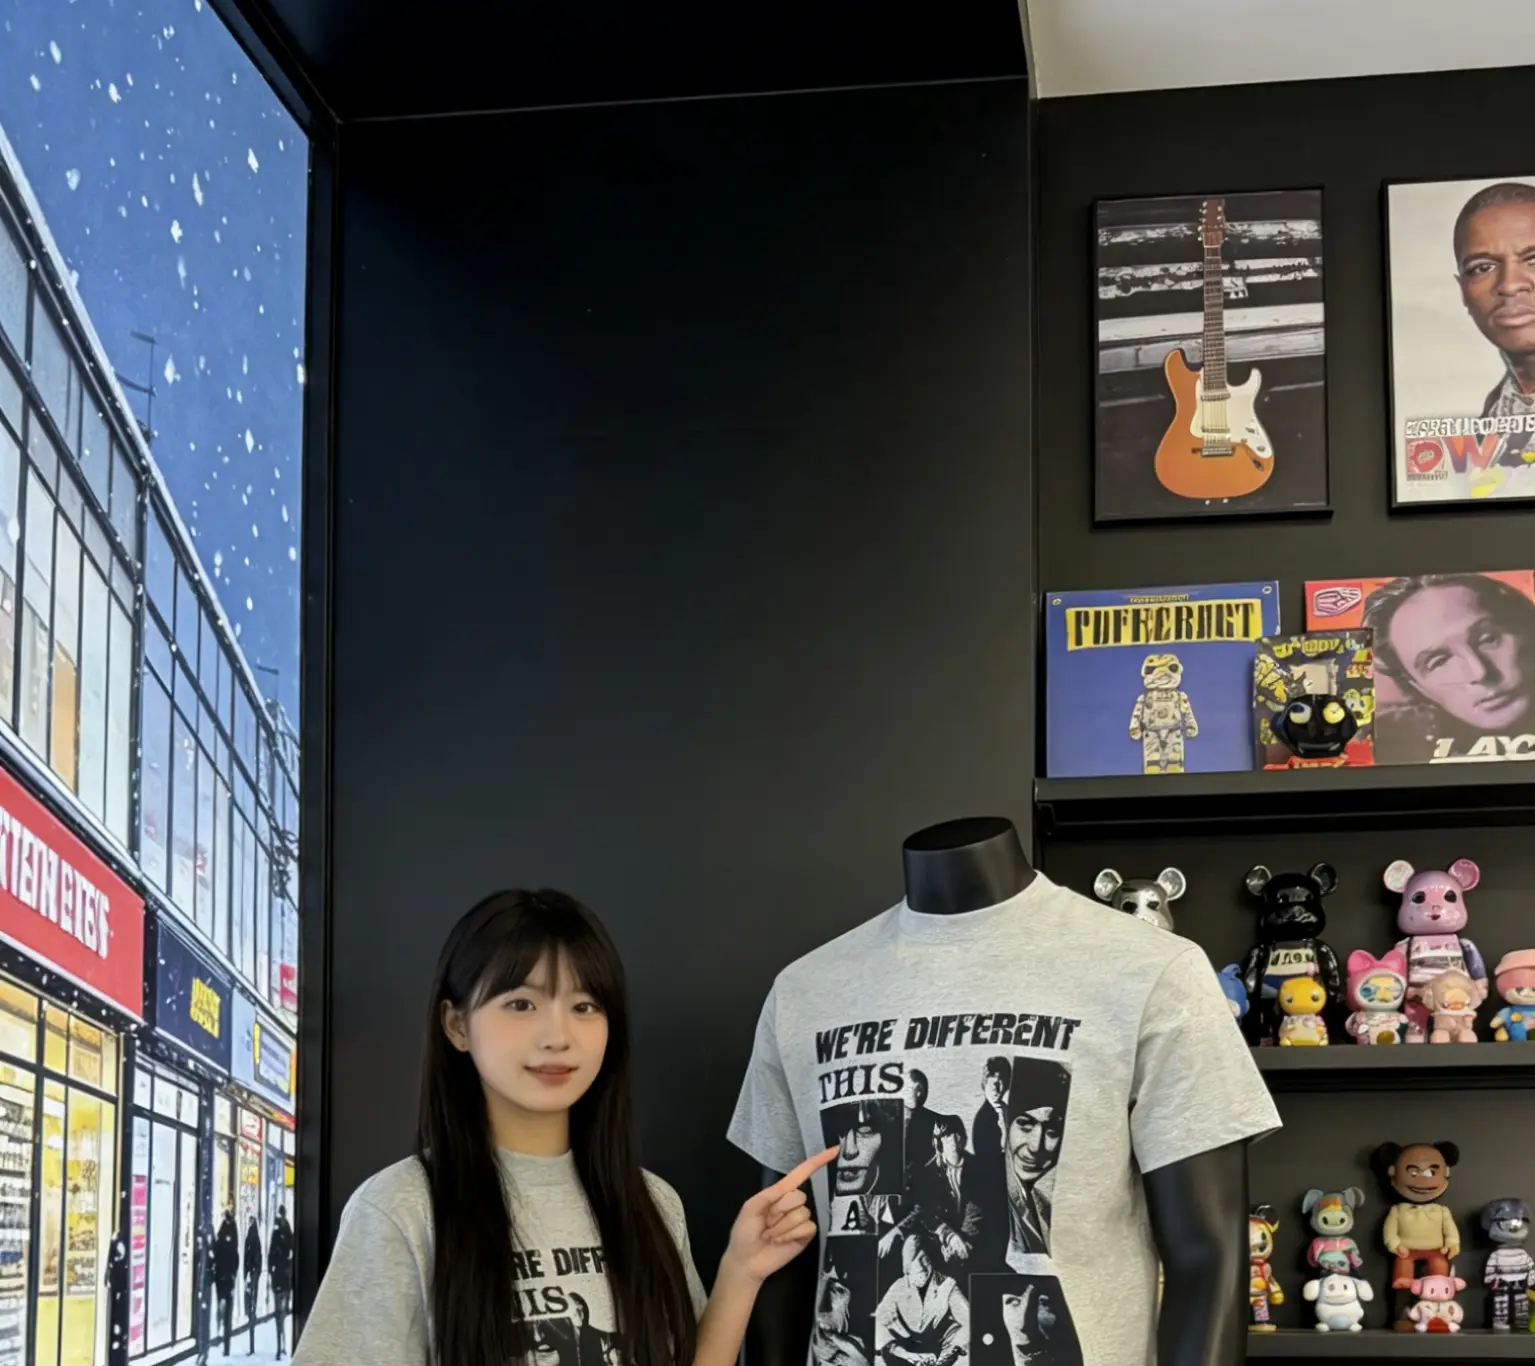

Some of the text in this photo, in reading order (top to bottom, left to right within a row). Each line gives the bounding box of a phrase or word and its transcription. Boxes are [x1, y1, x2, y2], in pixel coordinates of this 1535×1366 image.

[815, 1012, 1082, 1065] WE'RE DIFFERENT
[818, 1062, 905, 1104] THIS
[840, 1199, 863, 1231] A
[551, 1246, 605, 1276] DIFF
